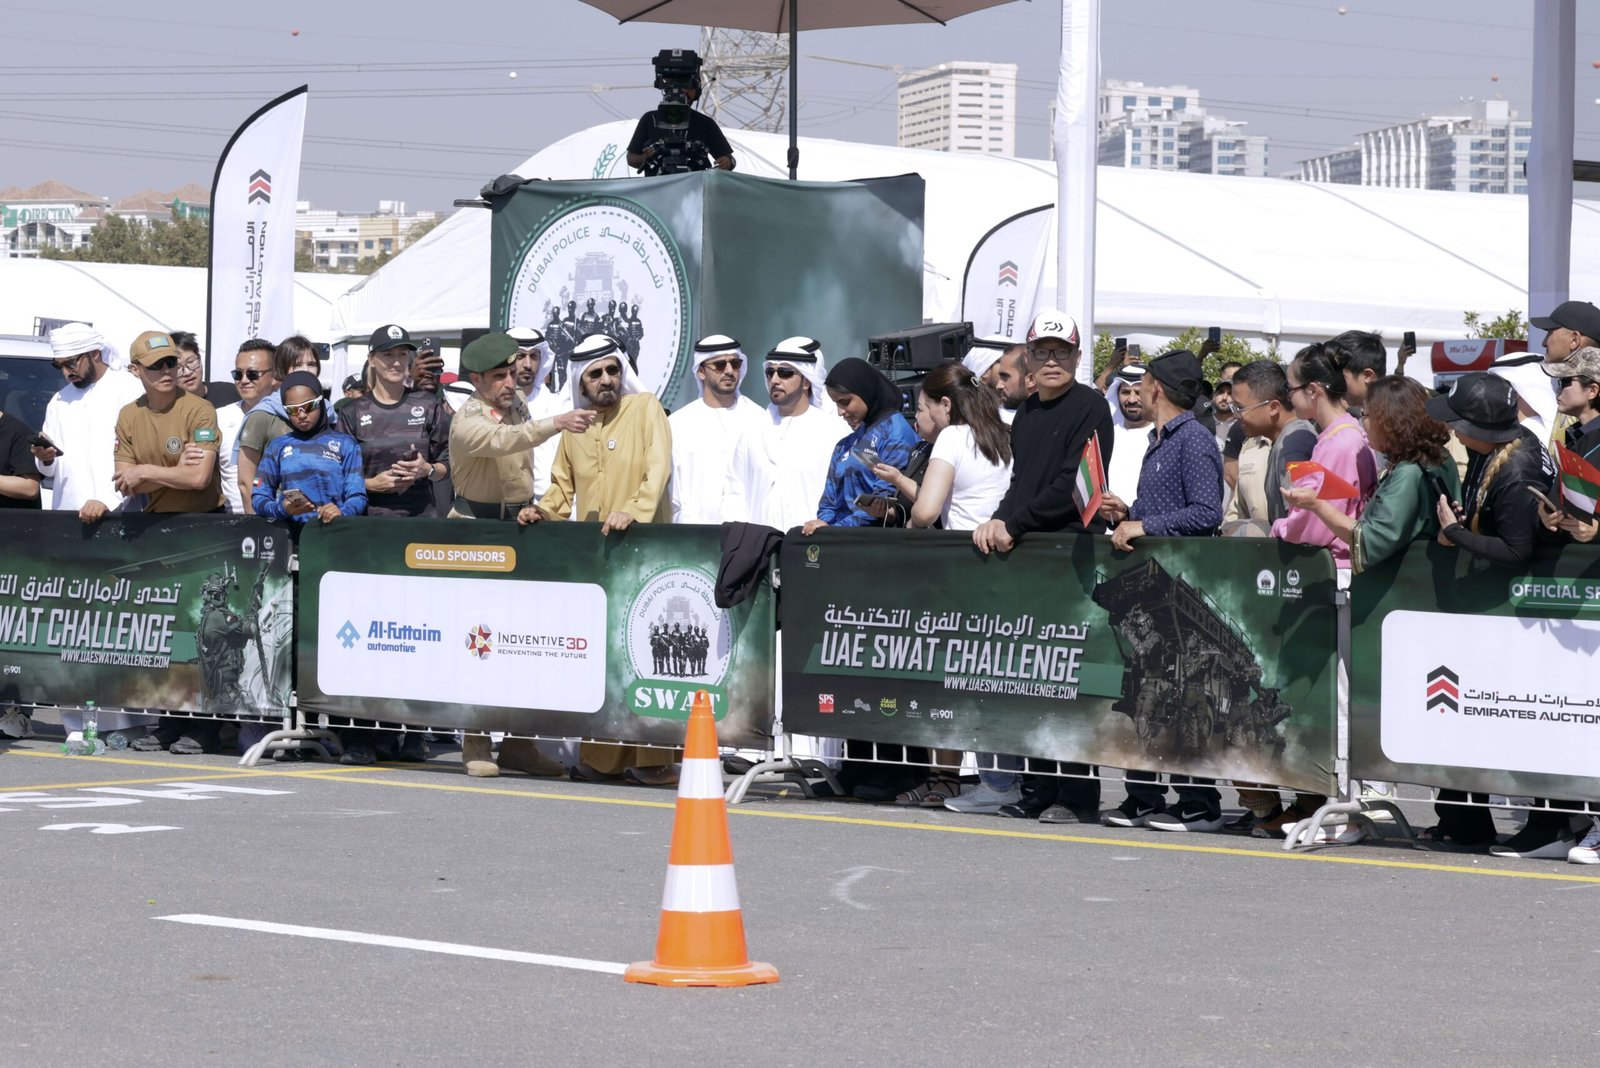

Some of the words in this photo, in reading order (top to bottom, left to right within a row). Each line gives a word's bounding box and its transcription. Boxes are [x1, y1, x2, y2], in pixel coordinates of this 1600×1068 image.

[528, 253, 554, 294] DUBAI
[552, 226, 591, 256] POLICE
[1006, 299, 1016, 337] CTION
[415, 549, 445, 560] GOLD
[447, 550, 506, 563] SPONSORS
[21, 576, 65, 601] للفرق
[68, 578, 131, 606] الإمارات
[134, 583, 181, 605] تحدي
[653, 580, 676, 597] POLICE
[1512, 583, 1581, 599] OFFICIAL
[824, 603, 911, 630] التكتيكية
[915, 612, 962, 634] للفرق
[965, 613, 1034, 640] الإمارات
[0, 605, 44, 644] WAT
[47, 608, 176, 654] CHALLENGE
[1037, 621, 1090, 640] تحدي
[367, 641, 416, 653] automotive
[497, 648, 542, 657] REINVENTING
[560, 652, 588, 660] FUTURE
[820, 630, 866, 668] UAE
[871, 634, 940, 672] SWAT
[944, 638, 1084, 684] CHALLENGE
[61, 649, 170, 669] WWW.UAESWATCHALLENGE.COM
[818, 693, 834, 705] SPS
[943, 676, 1078, 701] WWW.UAESWATCHALLENGE.COM
[939, 709, 953, 719] 901
[1464, 706, 1537, 720] EMIRATES
